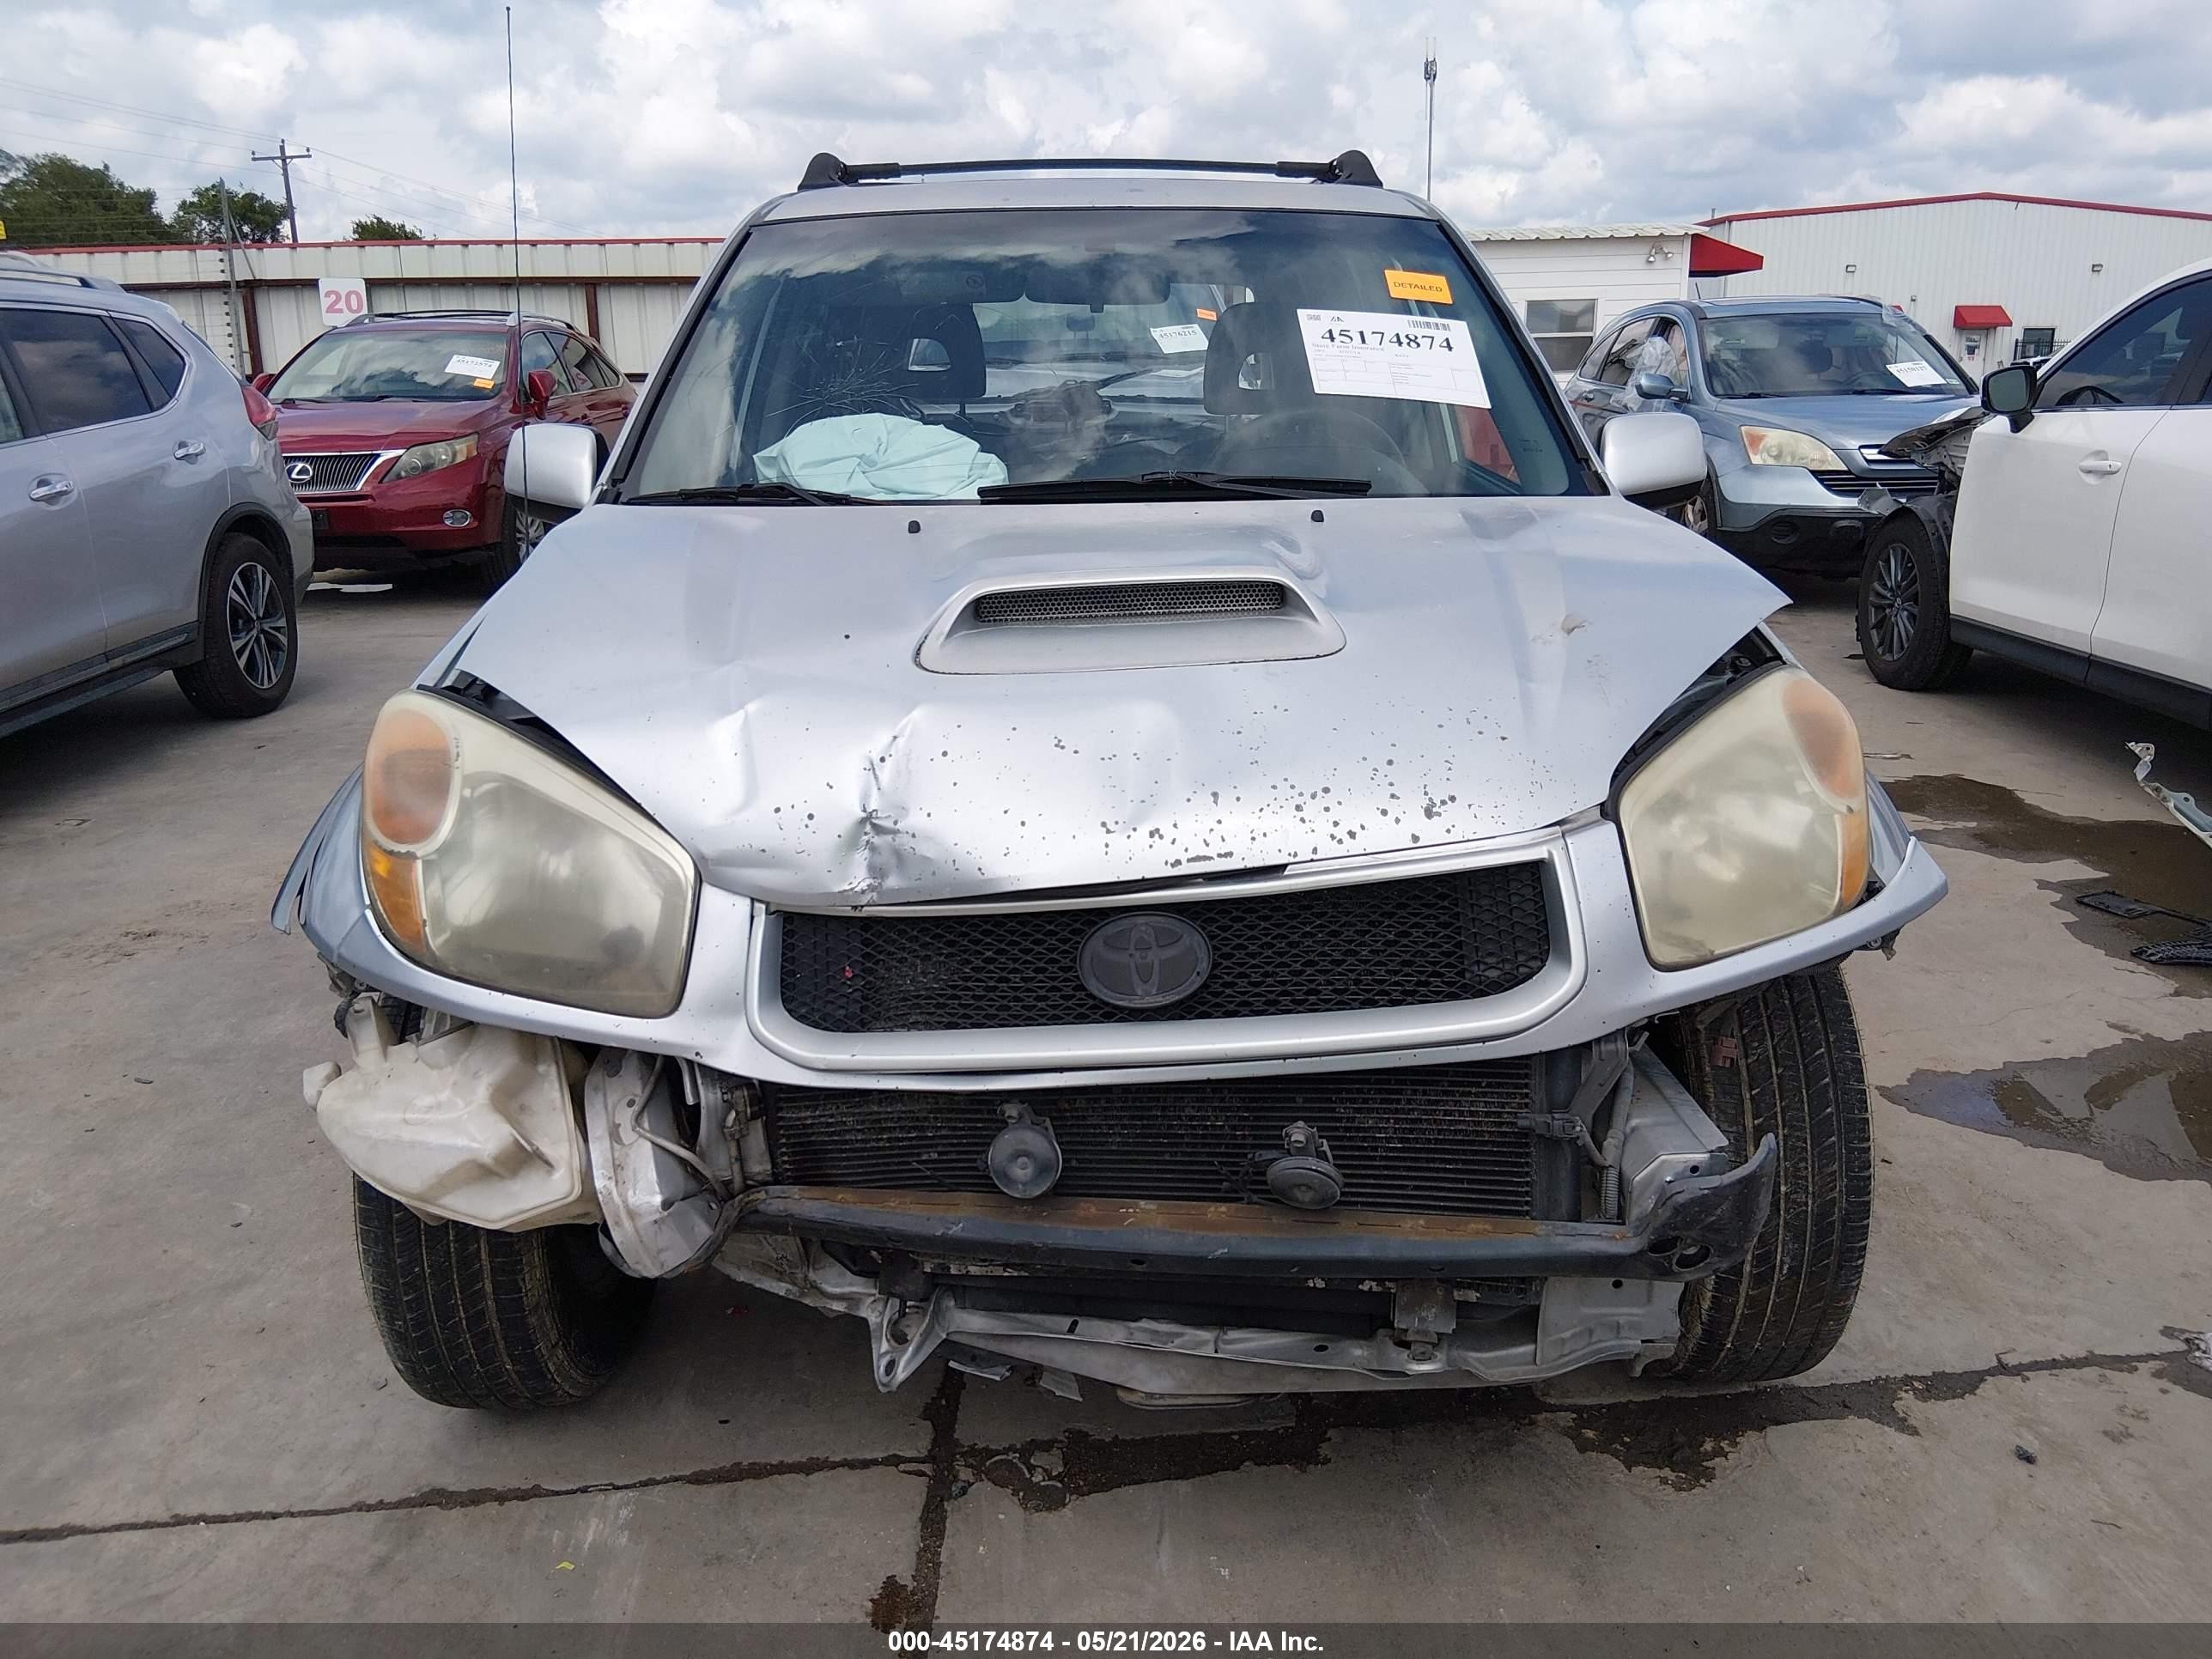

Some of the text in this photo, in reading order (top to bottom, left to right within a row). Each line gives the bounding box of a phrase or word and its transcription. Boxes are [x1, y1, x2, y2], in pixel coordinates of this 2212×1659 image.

[1394, 281, 1443, 293] DETAILED
[324, 289, 364, 314] 20
[1321, 328, 1454, 353] 45174874
